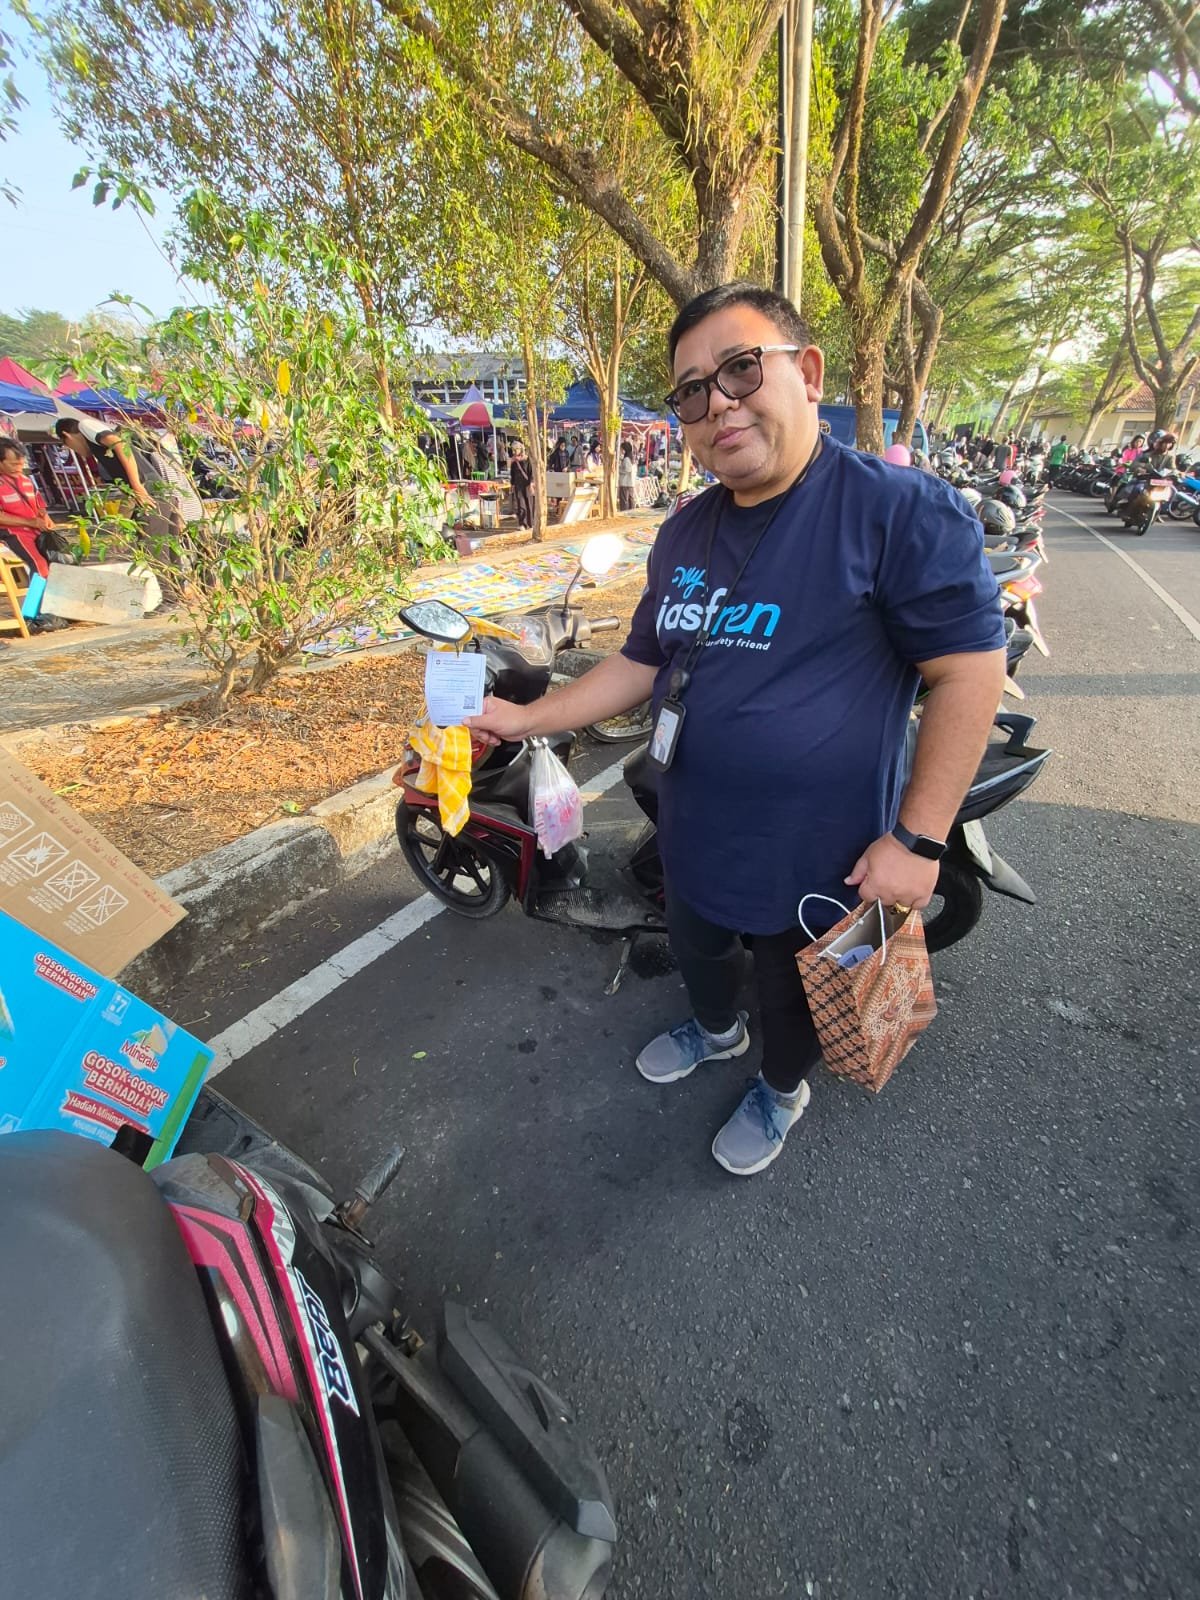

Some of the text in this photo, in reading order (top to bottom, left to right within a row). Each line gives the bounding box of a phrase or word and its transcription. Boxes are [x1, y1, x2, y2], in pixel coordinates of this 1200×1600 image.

[736, 638, 771, 651] friend
[36, 953, 98, 995] GOSOK-GOSOK
[38, 965, 89, 998] BERHADIAH
[120, 1040, 159, 1071] Minerale
[85, 1052, 168, 1105] GOSOK-GOSOK
[87, 1070, 155, 1112] BERHADIAH
[68, 1095, 98, 1115] Hadiah
